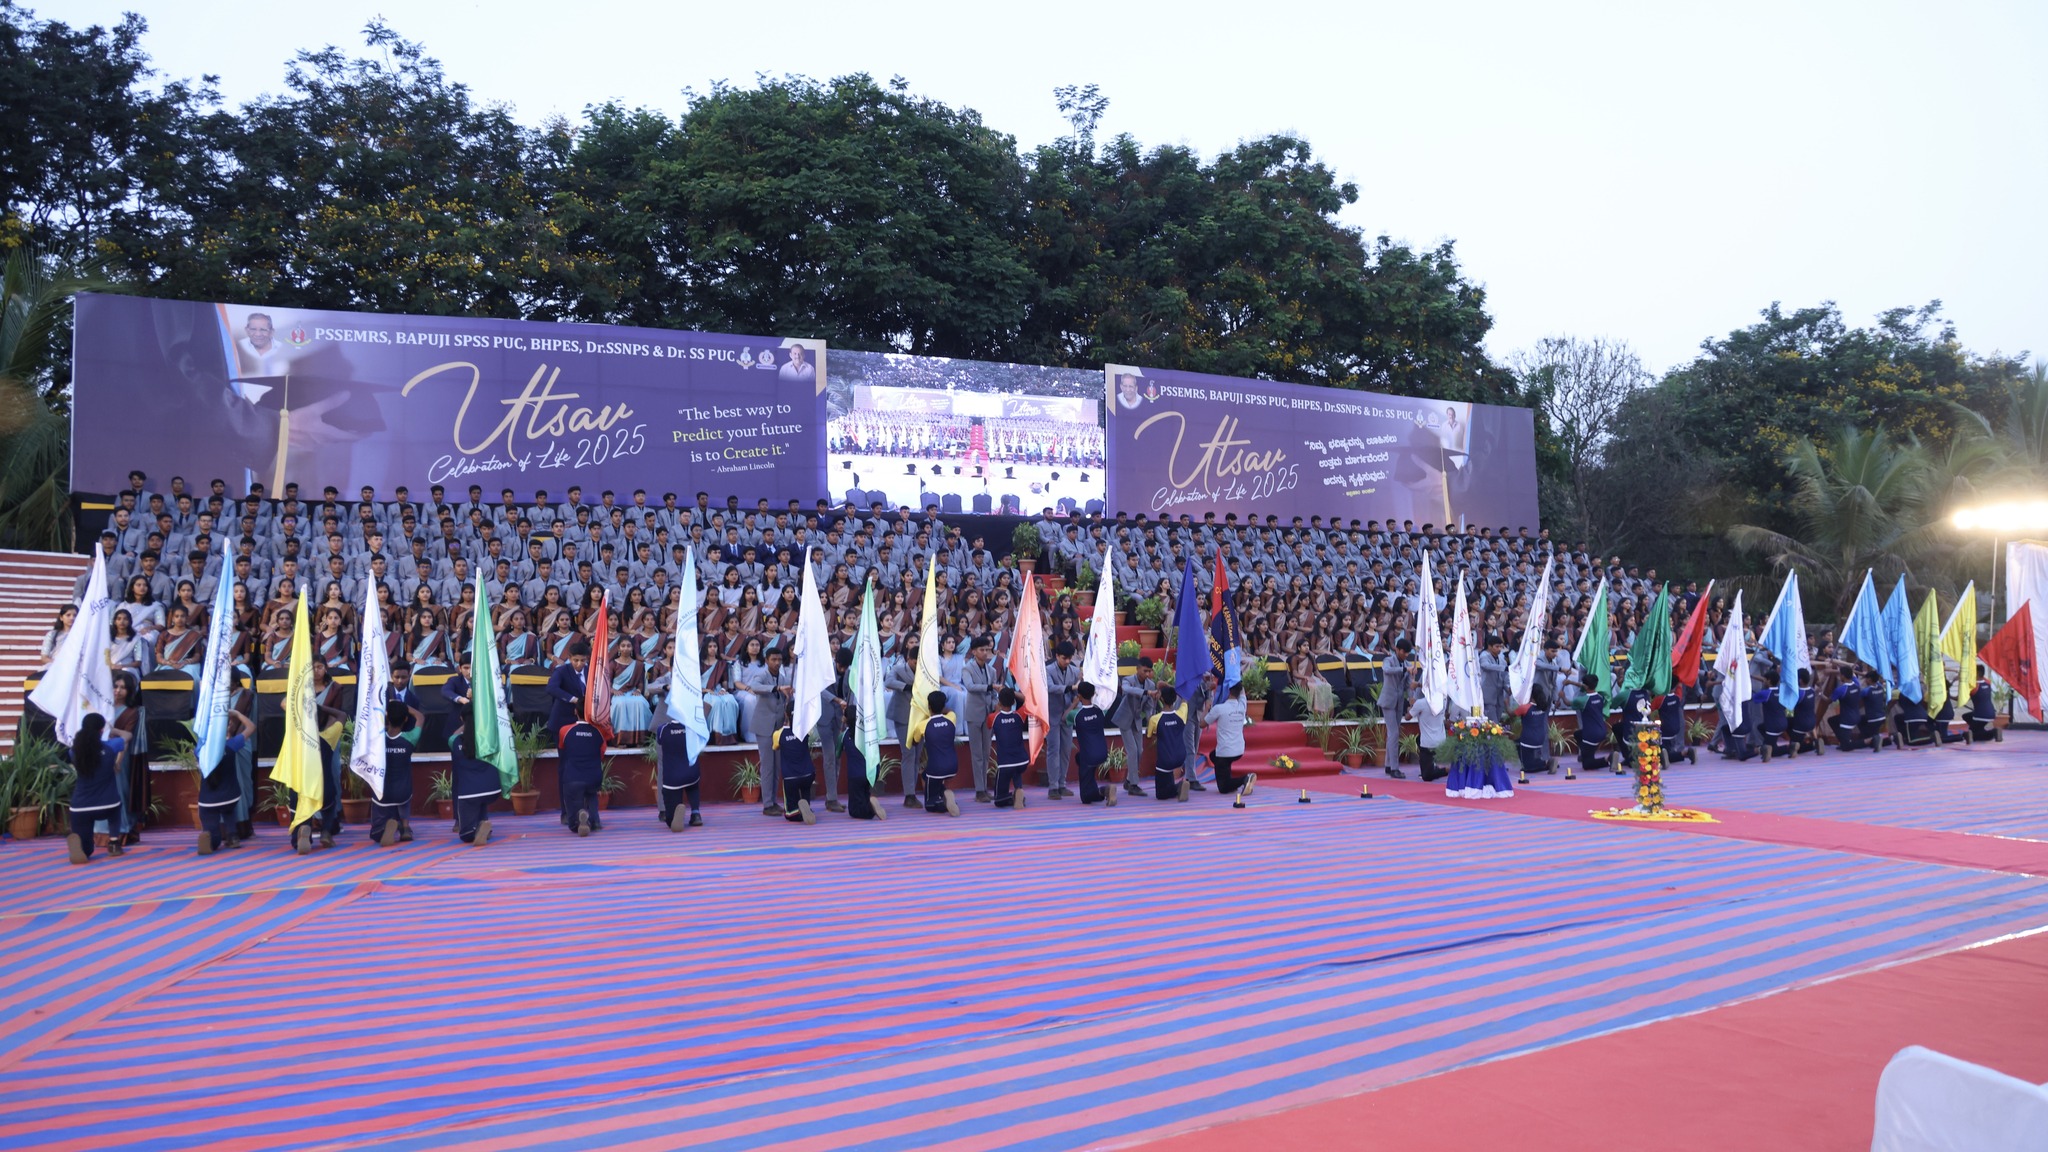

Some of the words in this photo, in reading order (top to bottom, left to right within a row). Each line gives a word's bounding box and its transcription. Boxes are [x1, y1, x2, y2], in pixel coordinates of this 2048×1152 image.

[314, 327, 392, 345] PSSEMRS,
[395, 331, 450, 348] BAPUJI
[453, 334, 490, 348] SPSS
[493, 336, 527, 351] PUC,
[530, 338, 583, 354] BHPES,
[586, 340, 649, 357] Dr.SSNPS
[652, 345, 664, 358] &
[667, 346, 686, 359] Dr.
[689, 347, 705, 360] SS
[708, 348, 735, 363] PUC
[401, 361, 634, 462] Utsav
[678, 406, 711, 421] "The
[712, 405, 742, 419] best
[745, 405, 774, 418] way
[776, 403, 791, 414] to
[1160, 385, 1208, 401] PSSEMRS,
[1209, 390, 1243, 405] BAPUJI
[1245, 393, 1267, 406] SPSS
[1268, 396, 1290, 409] PUC,
[1291, 398, 1323, 413] BHPES,
[1324, 402, 1362, 416] Dr.SSNPS
[1363, 406, 1371, 416] &
[1372, 407, 1384, 418] Dr.
[1385, 408, 1395, 419] SS
[1396, 410, 1414, 421] PUC
[672, 427, 724, 443] Predict
[726, 427, 758, 442] your
[761, 422, 803, 436] future
[428, 454, 513, 484] Celebration
[518, 452, 531, 472] of
[536, 440, 571, 469] Life
[574, 424, 647, 469] 2025
[690, 450, 703, 463] is
[705, 450, 720, 461] to
[723, 446, 769, 460] Create
[771, 442, 790, 456] it."
[716, 464, 748, 473] Abraham
[749, 461, 775, 471] Lincoln
[1134, 411, 1287, 495] Utsav
[1151, 487, 1208, 512] Celebration
[1211, 486, 1221, 503] of
[1223, 477, 1247, 501] Life
[1250, 463, 1299, 501] 2025
